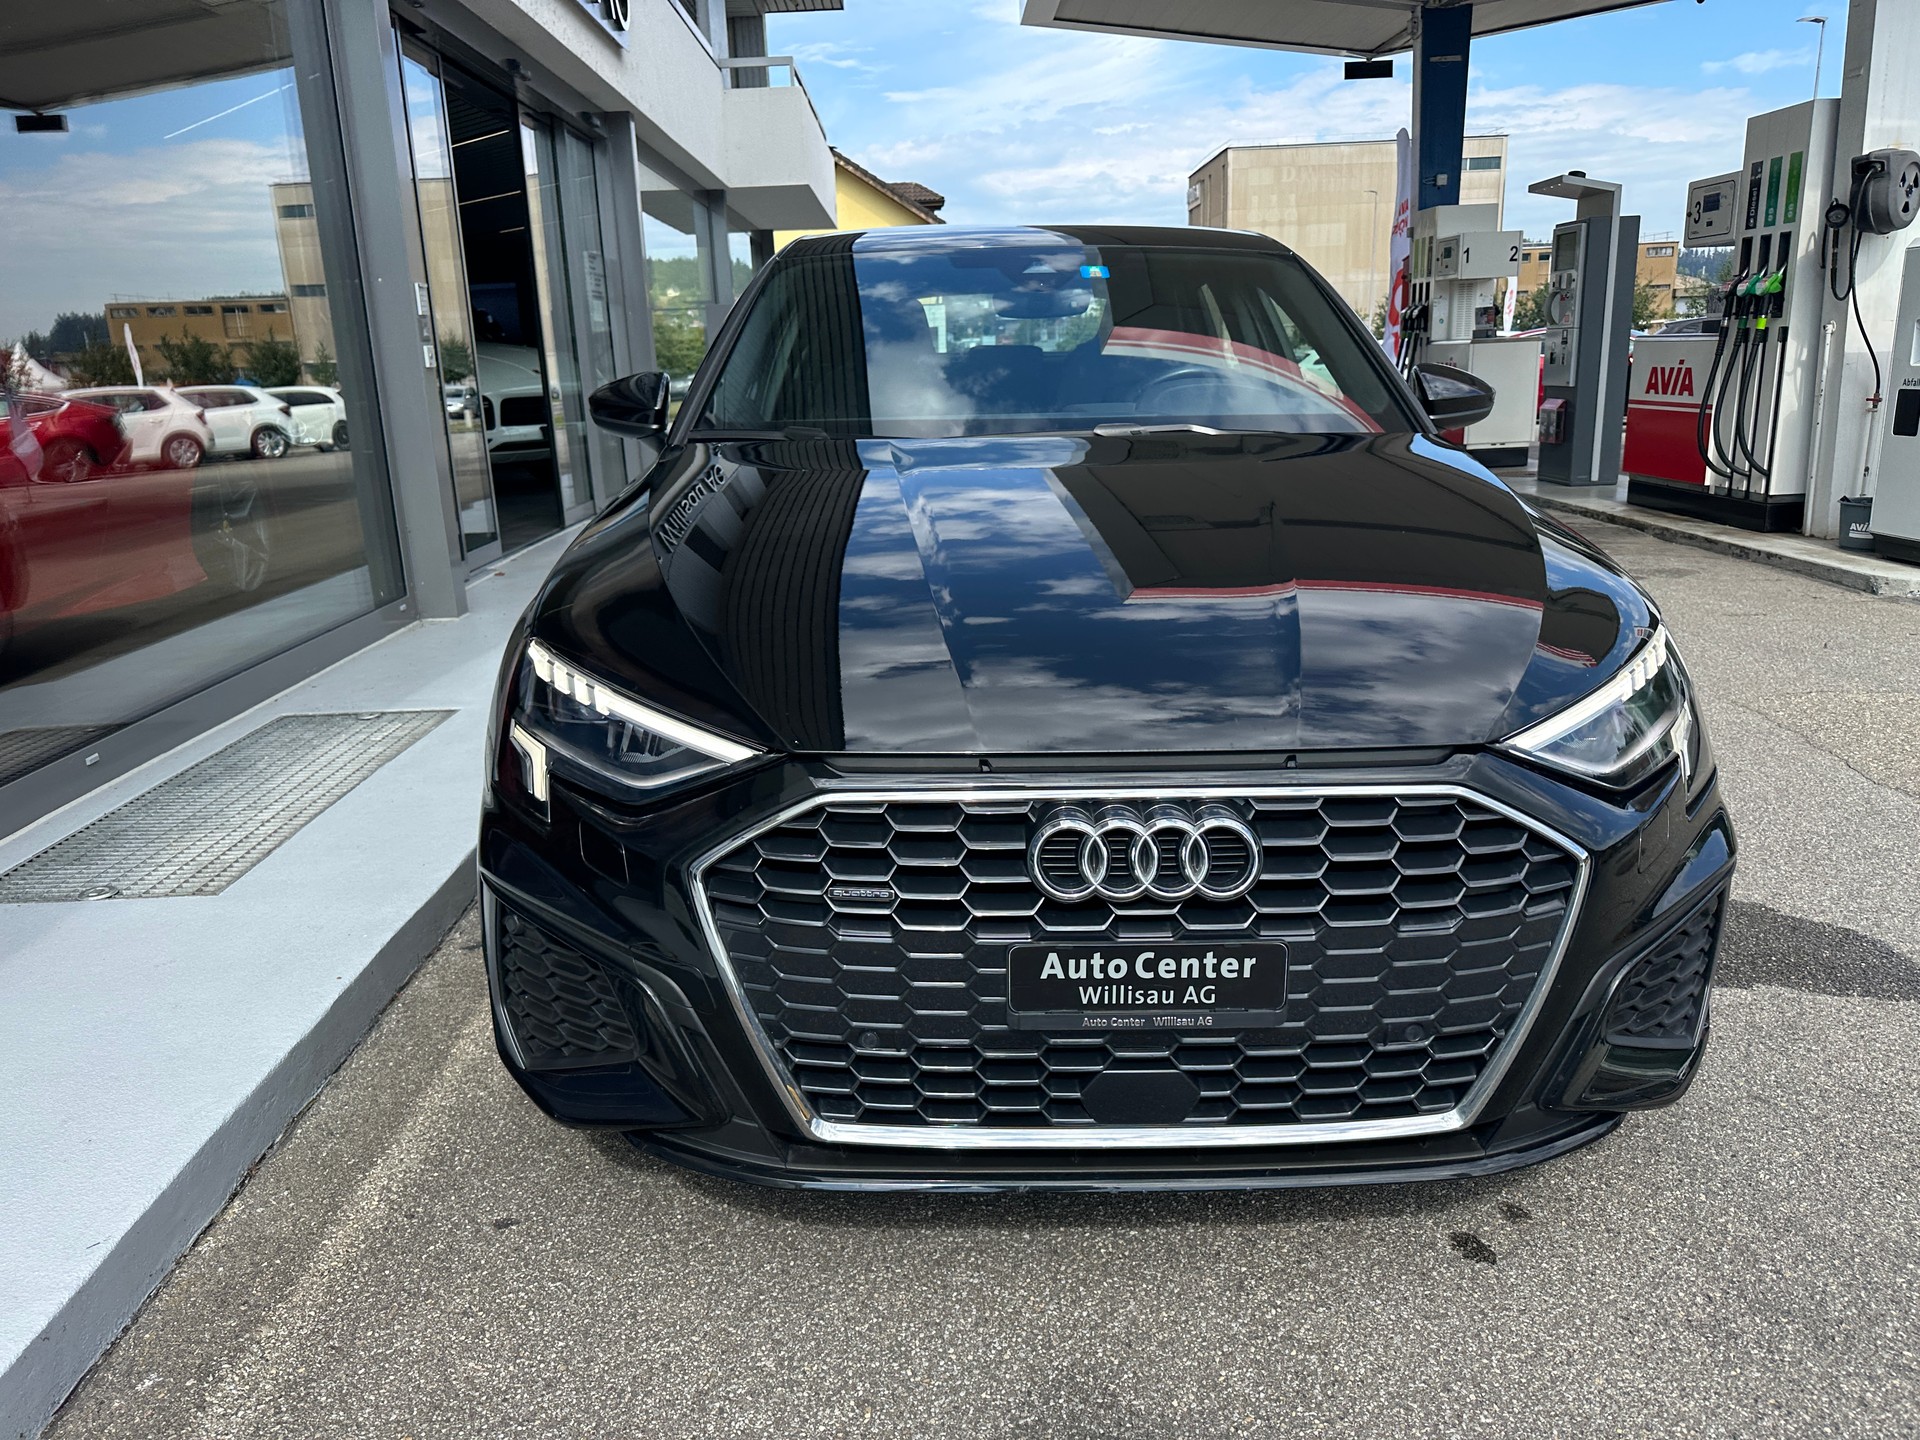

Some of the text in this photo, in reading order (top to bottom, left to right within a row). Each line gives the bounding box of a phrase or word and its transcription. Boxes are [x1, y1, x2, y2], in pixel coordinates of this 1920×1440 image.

[1693, 201, 1701, 224] 3
[1463, 247, 1470, 264] 1
[1509, 245, 1519, 262] 2
[1645, 359, 1694, 397] AVIA
[1849, 522, 1871, 531] AVI
[833, 889, 889, 898] quattro
[1040, 951, 1257, 980] Auto Center
[1079, 984, 1217, 1005] Willisau AG
[1082, 1016, 1213, 1027] Auto Center Willisau AG
